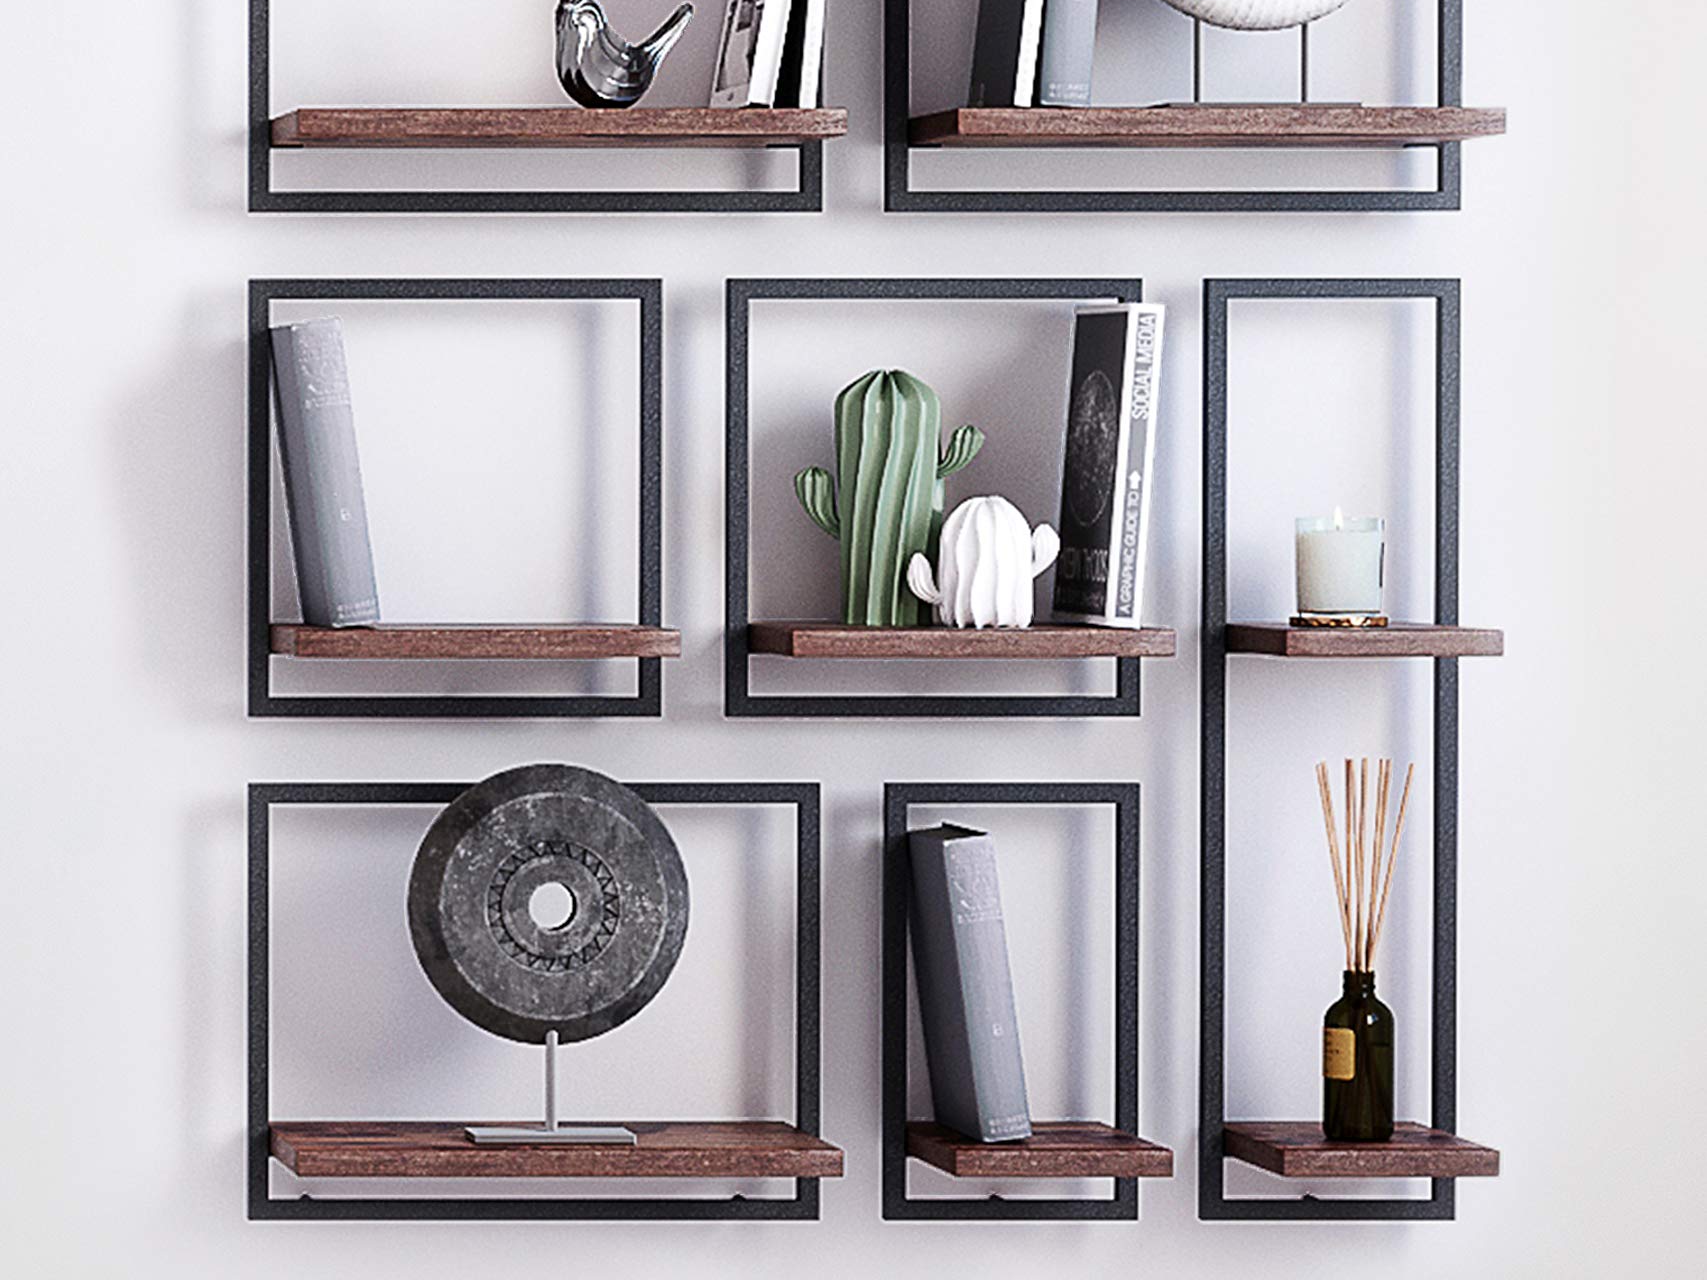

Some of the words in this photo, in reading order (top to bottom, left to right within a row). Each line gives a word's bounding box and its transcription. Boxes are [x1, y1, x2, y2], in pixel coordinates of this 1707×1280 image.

[1135, 313, 1157, 364] MEDIA
[1132, 365, 1152, 420] SOCIAL
[1127, 491, 1139, 507] TO
[1123, 508, 1138, 547] GUIDE
[1119, 547, 1135, 603] GRAPHIC
[1119, 604, 1131, 614] A
